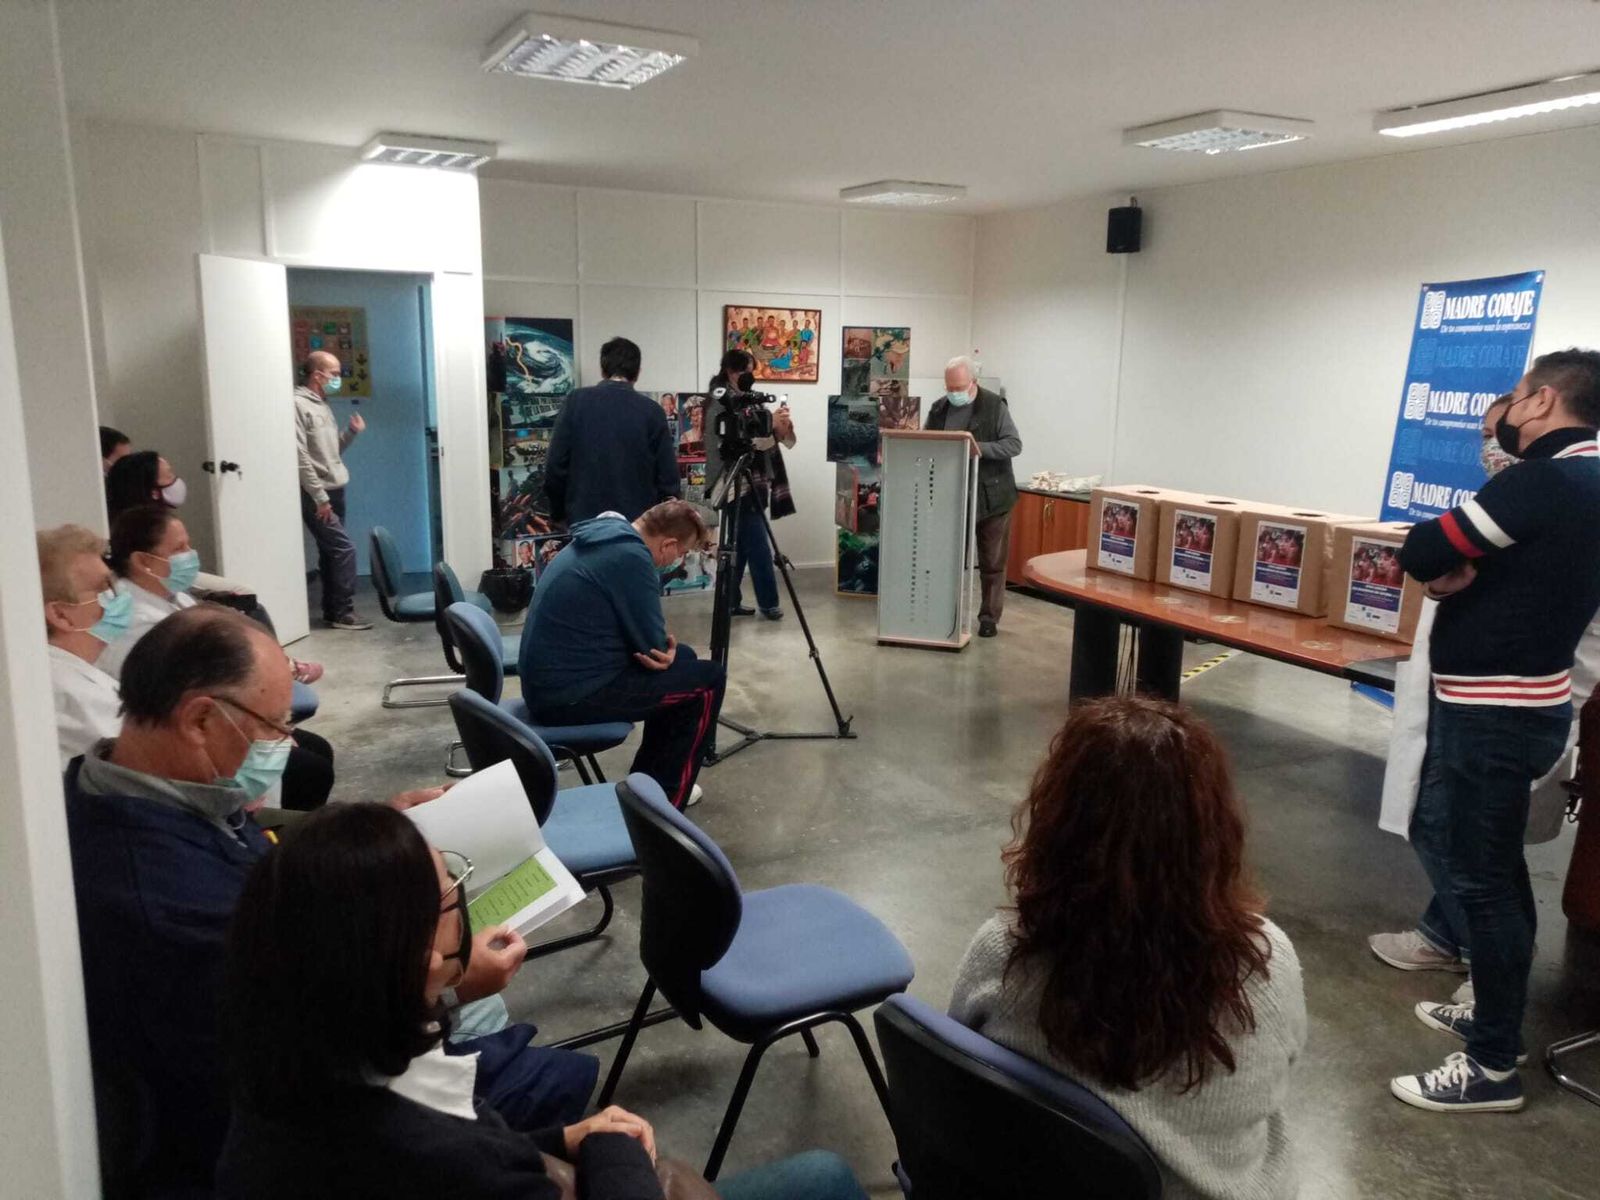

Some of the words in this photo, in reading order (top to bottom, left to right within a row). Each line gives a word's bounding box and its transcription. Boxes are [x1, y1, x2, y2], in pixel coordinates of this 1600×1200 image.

[1443, 295, 1487, 320] MADRE
[1488, 291, 1535, 322] CORAJE
[1427, 391, 1470, 415] MADRE
[1470, 392, 1502, 416] COR
[1411, 481, 1452, 509] MADRE
